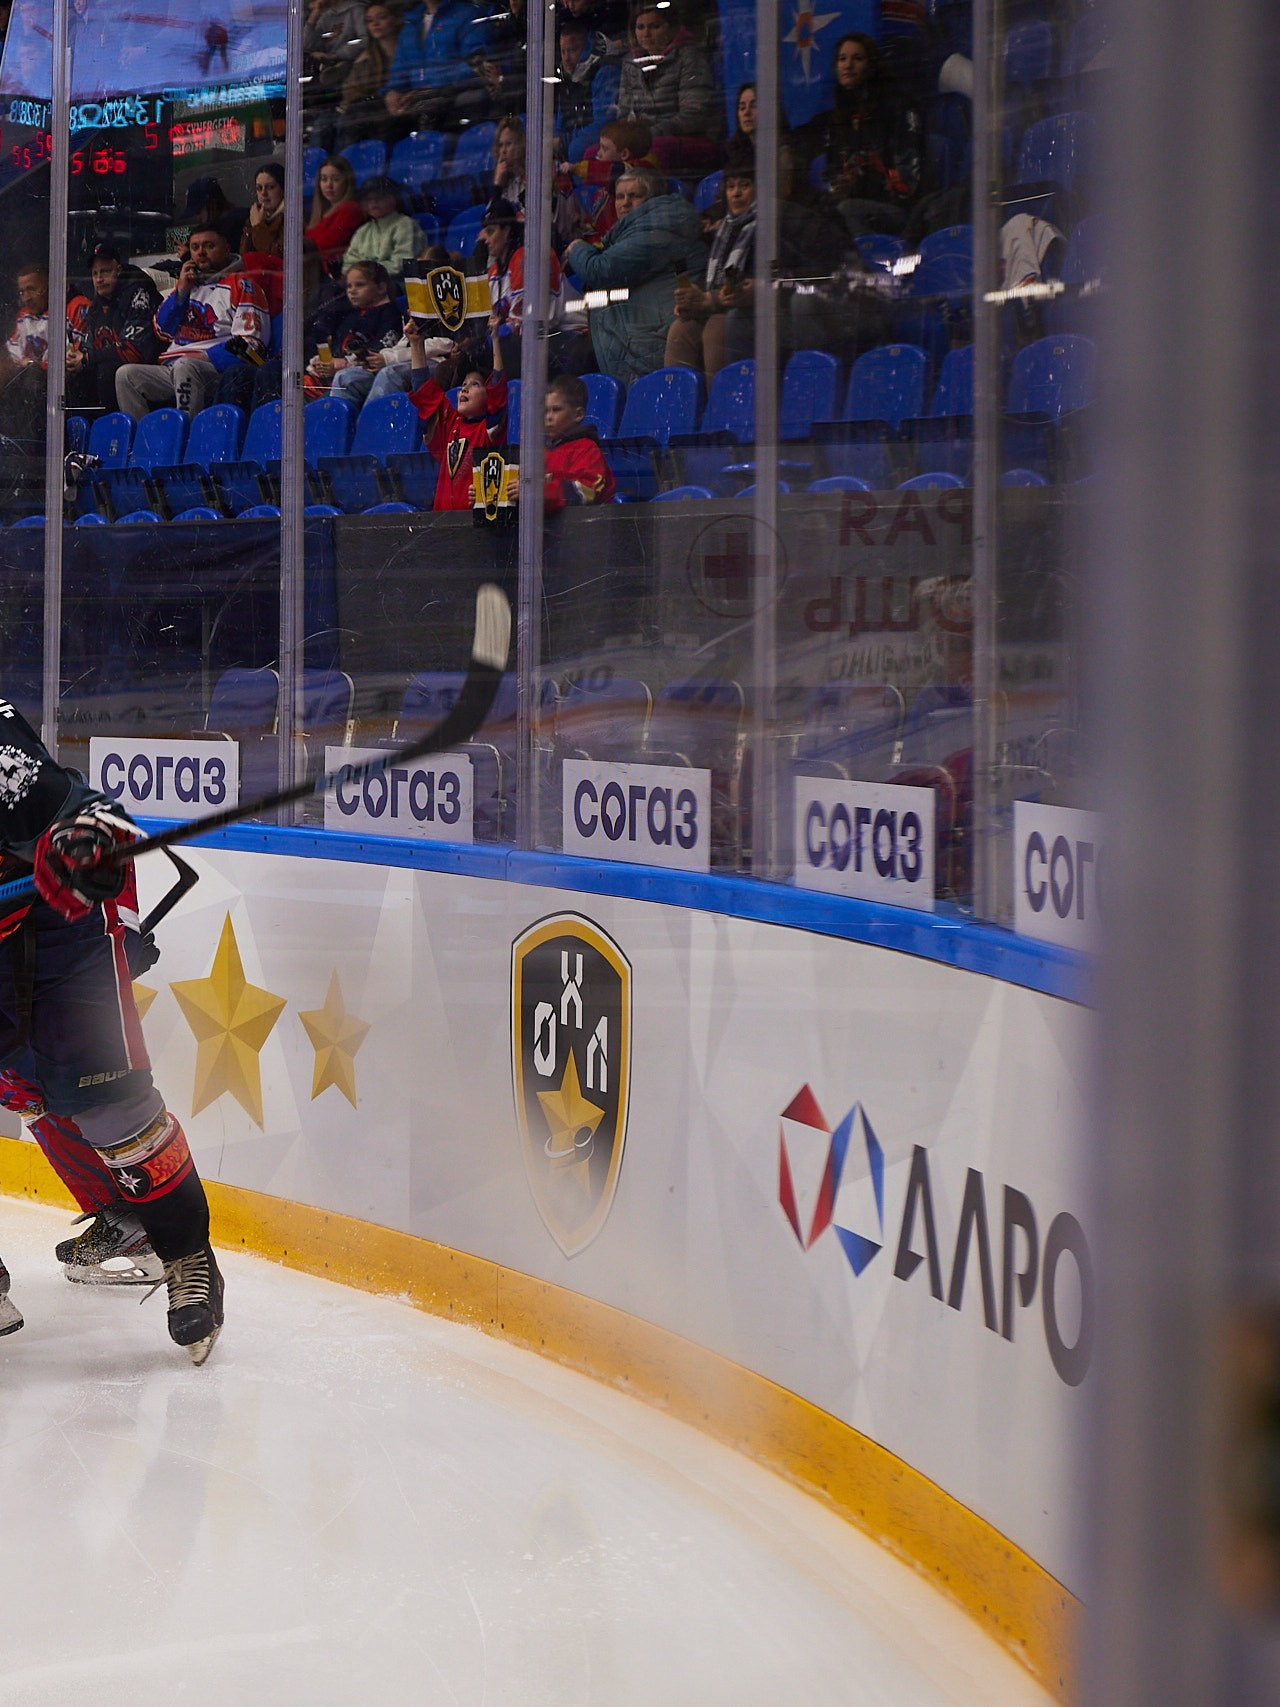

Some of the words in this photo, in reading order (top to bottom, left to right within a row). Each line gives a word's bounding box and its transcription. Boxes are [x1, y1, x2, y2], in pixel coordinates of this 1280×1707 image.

[101, 752, 227, 805] согаз
[337, 763, 461, 825] согаз
[574, 779, 699, 850] согаз
[806, 800, 923, 883] согаз
[1025, 830, 1094, 921] сог
[78, 1069, 131, 1088] BAUE
